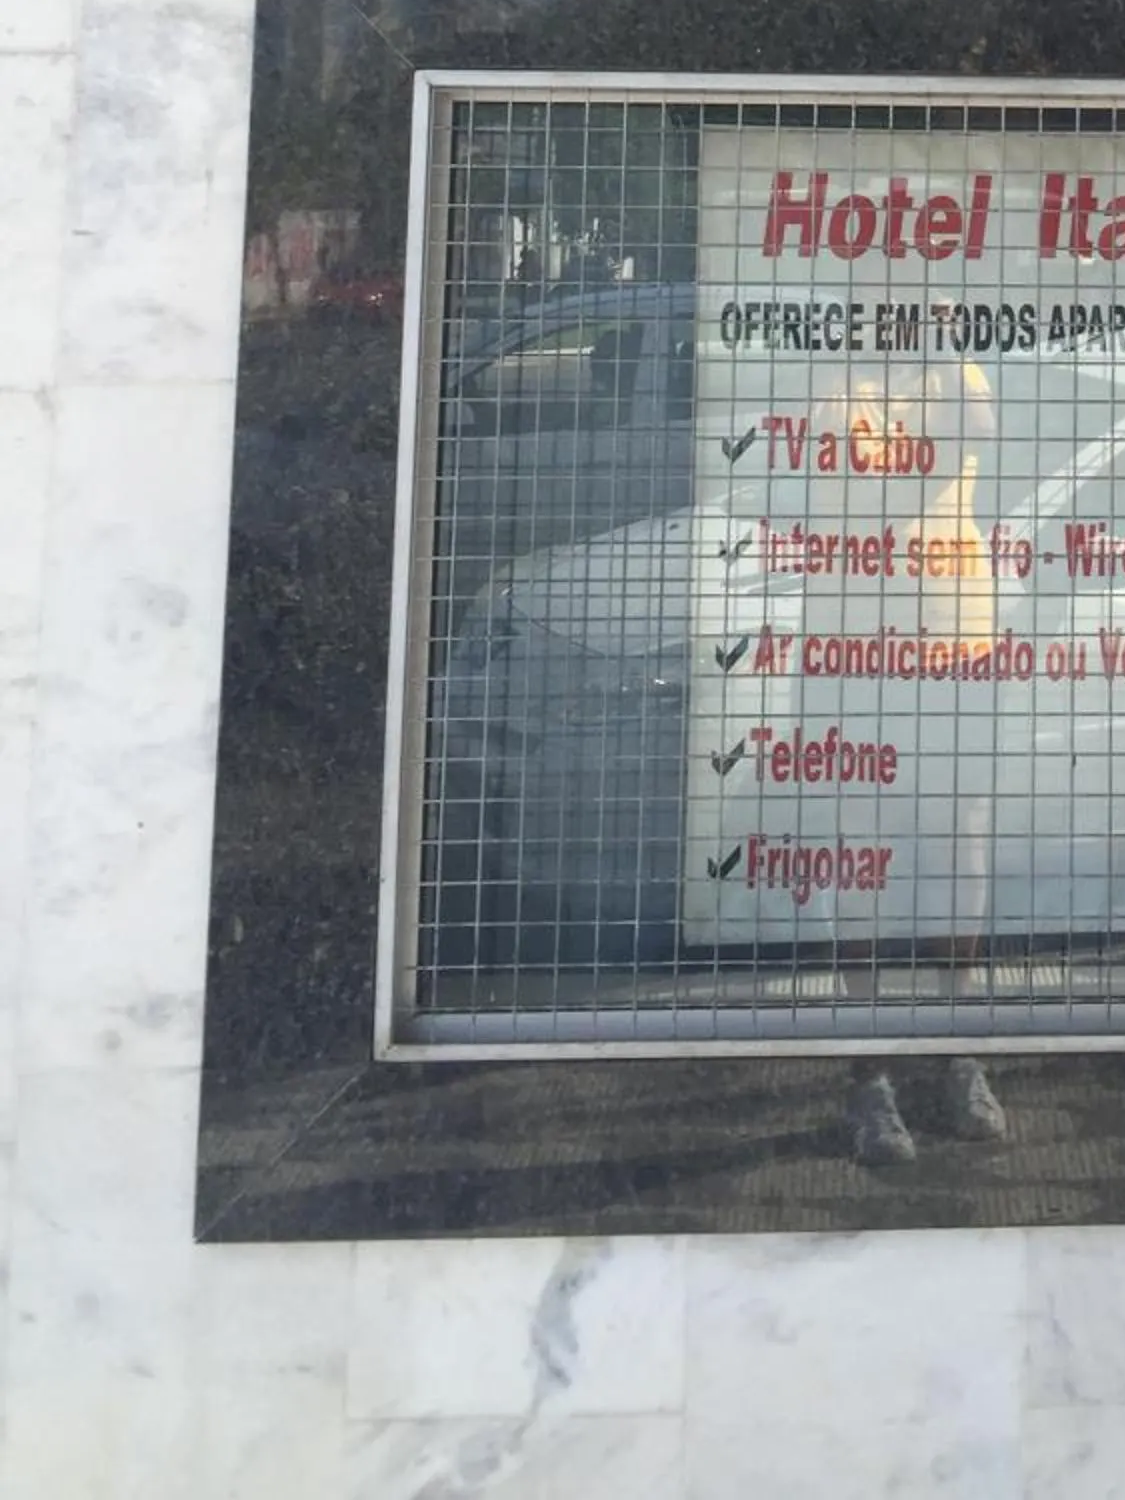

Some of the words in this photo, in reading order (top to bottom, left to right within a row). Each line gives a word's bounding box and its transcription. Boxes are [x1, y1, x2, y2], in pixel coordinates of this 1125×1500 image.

[762, 171, 993, 261] Hotel
[720, 302, 864, 351] OFERECE
[875, 305, 920, 351] EM
[931, 303, 1036, 352] TODOS
[762, 416, 808, 471] TV
[849, 420, 936, 475] Cabo
[758, 519, 895, 577] Internet
[906, 533, 978, 576] sem
[753, 625, 793, 675] Ar
[802, 626, 1034, 680] condicionado
[1046, 643, 1086, 681] ou
[750, 727, 898, 784] Telefone
[745, 833, 893, 904] Frigobar
